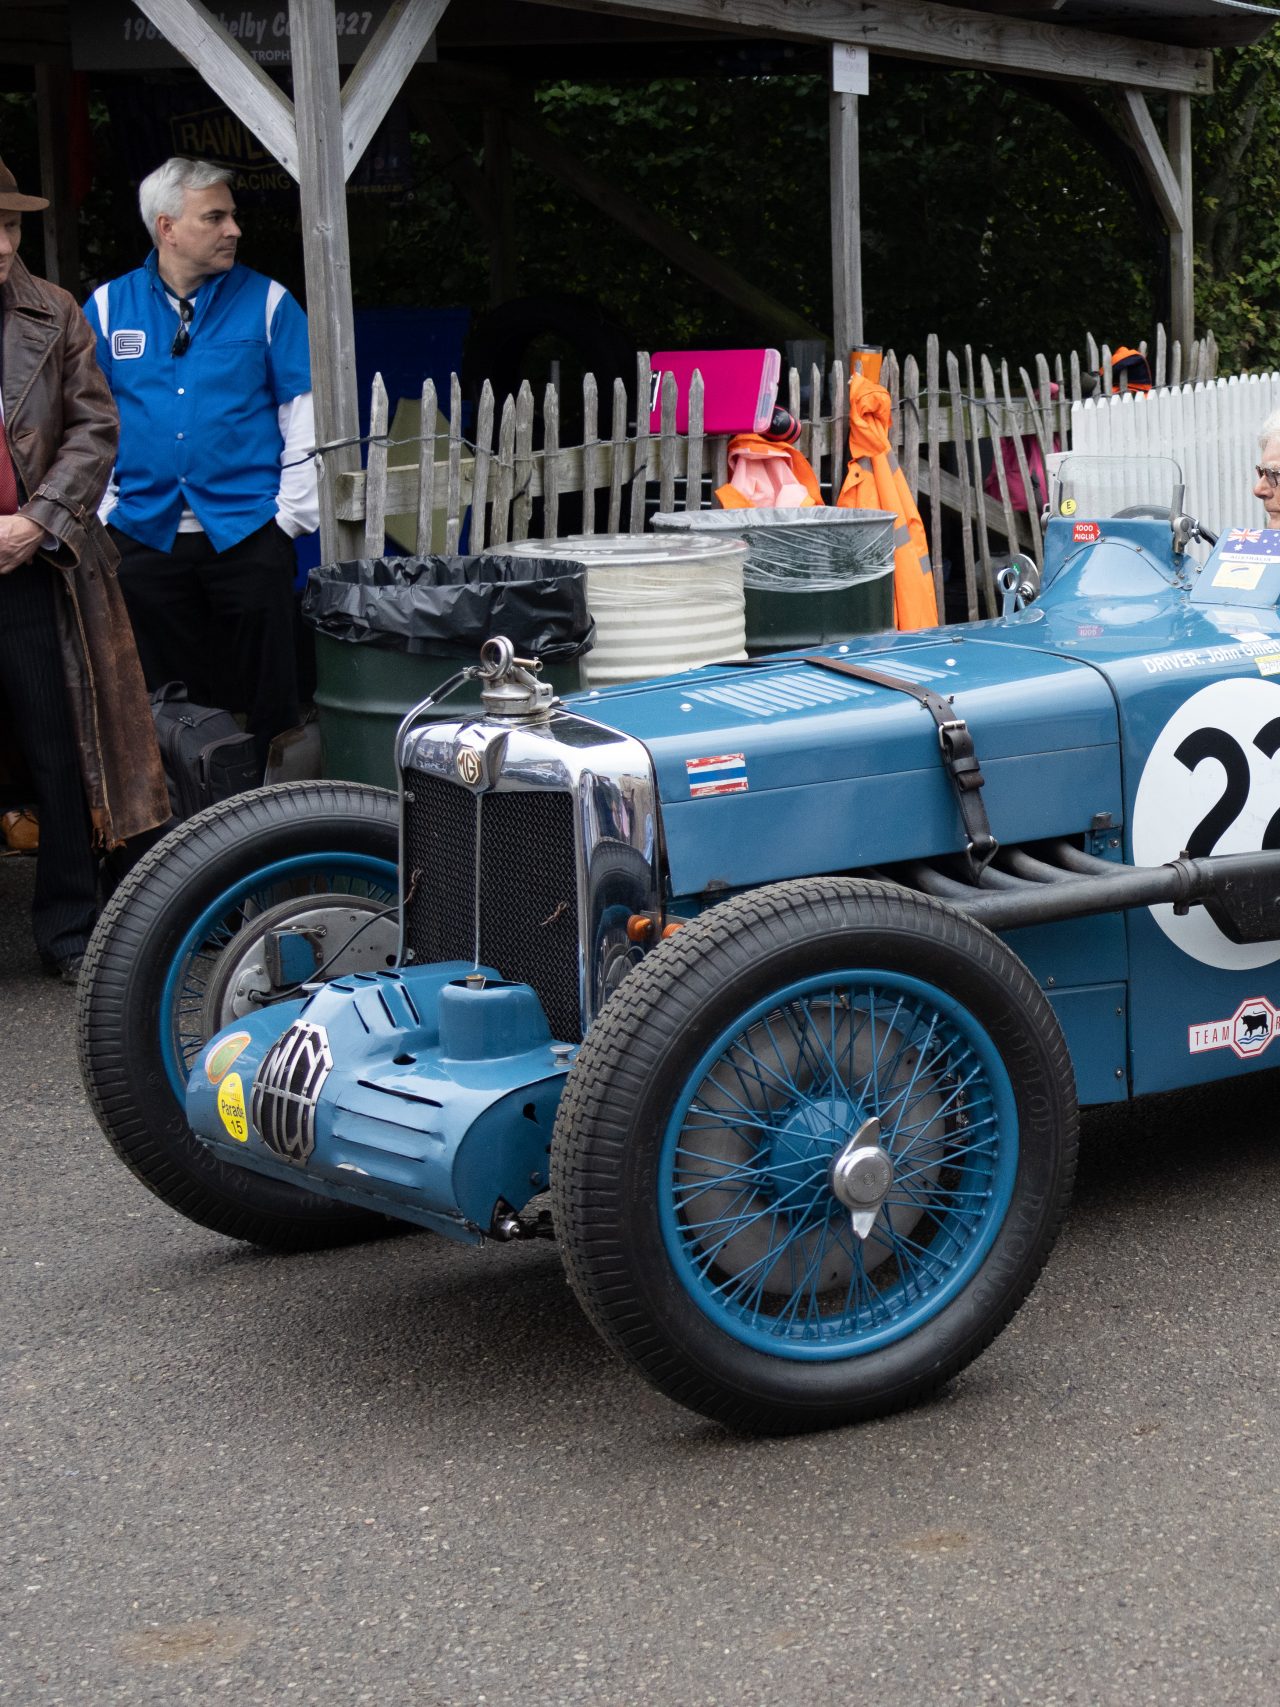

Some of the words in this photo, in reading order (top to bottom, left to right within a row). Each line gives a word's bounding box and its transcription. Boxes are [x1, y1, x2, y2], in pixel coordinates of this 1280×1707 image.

[251, 50, 292, 61] TROPH
[1142, 652, 1206, 674] DRIVER:
[1206, 648, 1241, 664] John
[457, 749, 481, 784] MG
[1194, 1025, 1230, 1046] TEAM
[221, 1099, 245, 1120] Parade
[231, 1120, 244, 1135] 15
